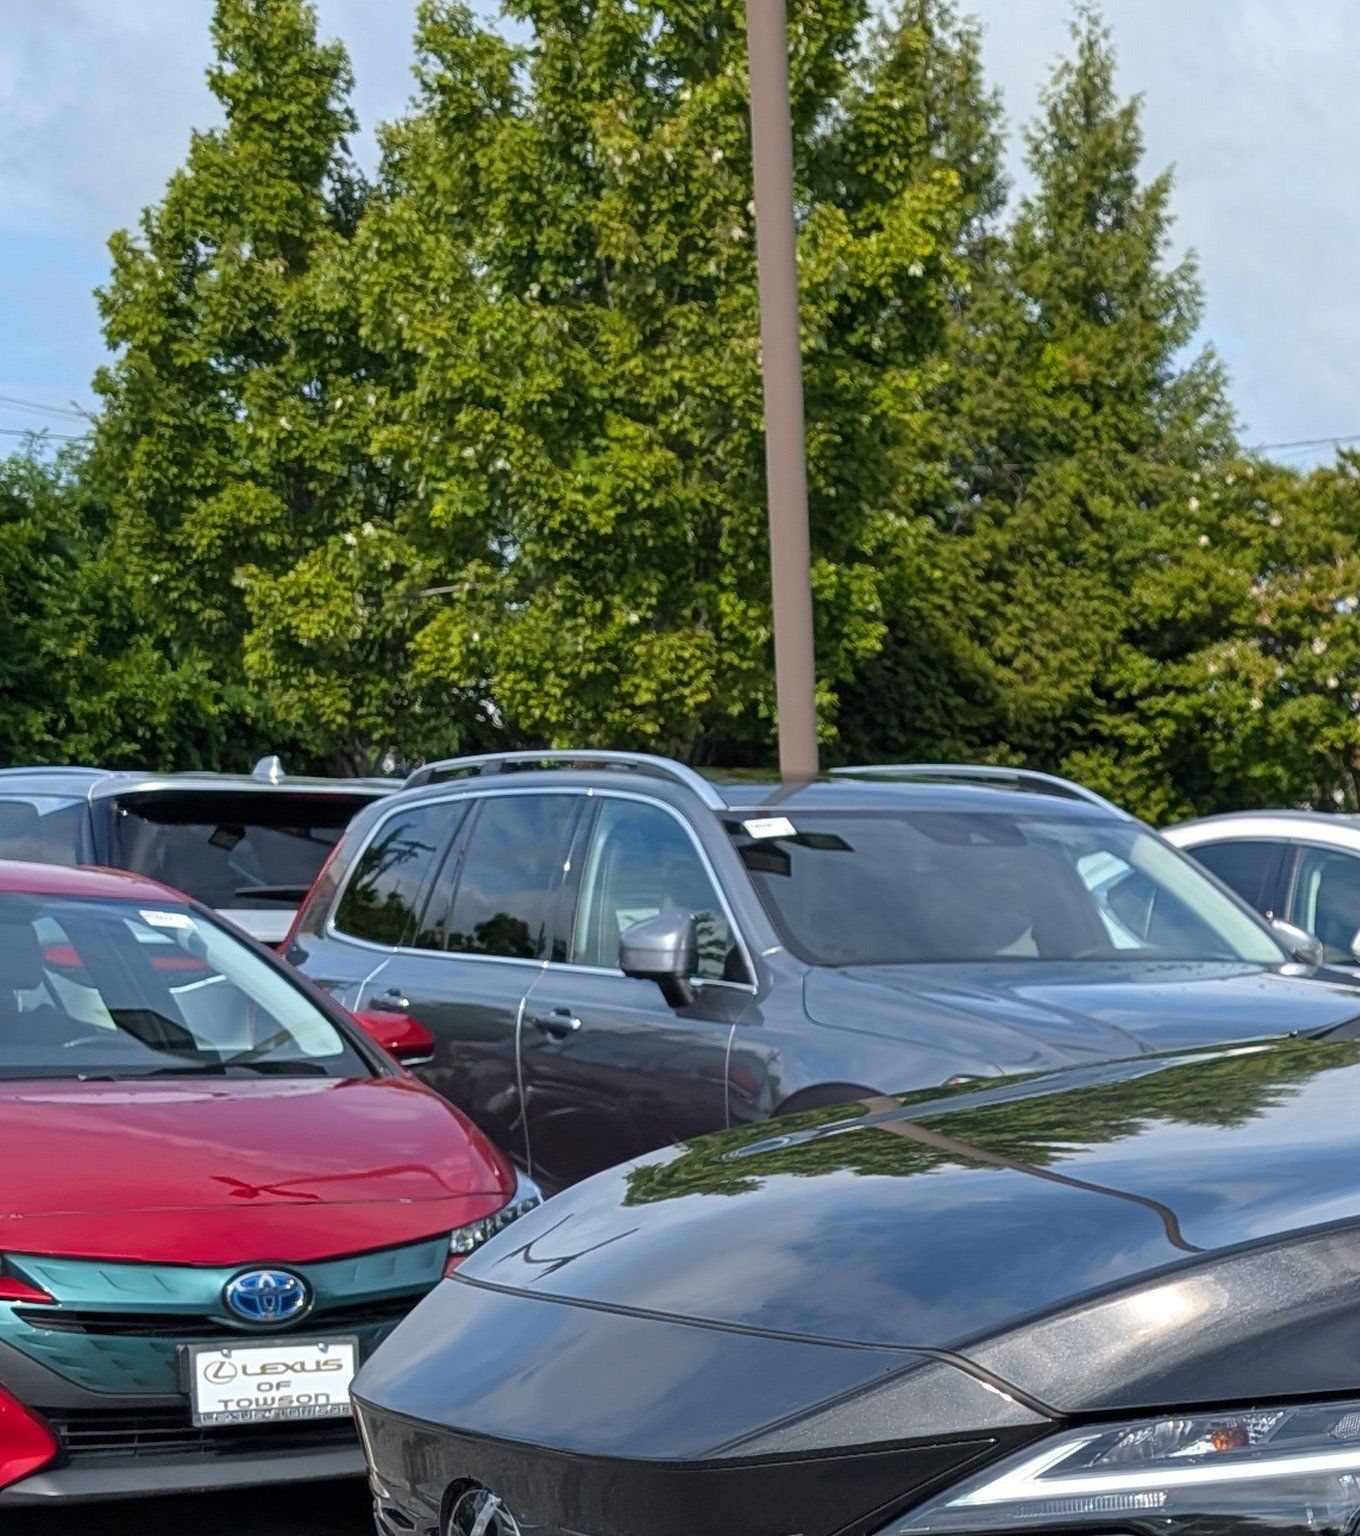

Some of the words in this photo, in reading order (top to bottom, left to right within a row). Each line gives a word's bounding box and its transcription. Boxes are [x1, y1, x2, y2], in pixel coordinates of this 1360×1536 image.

[241, 1357, 344, 1377] LEXUS
[256, 1380, 292, 1392] OF
[217, 1392, 331, 1411] TOWSON
